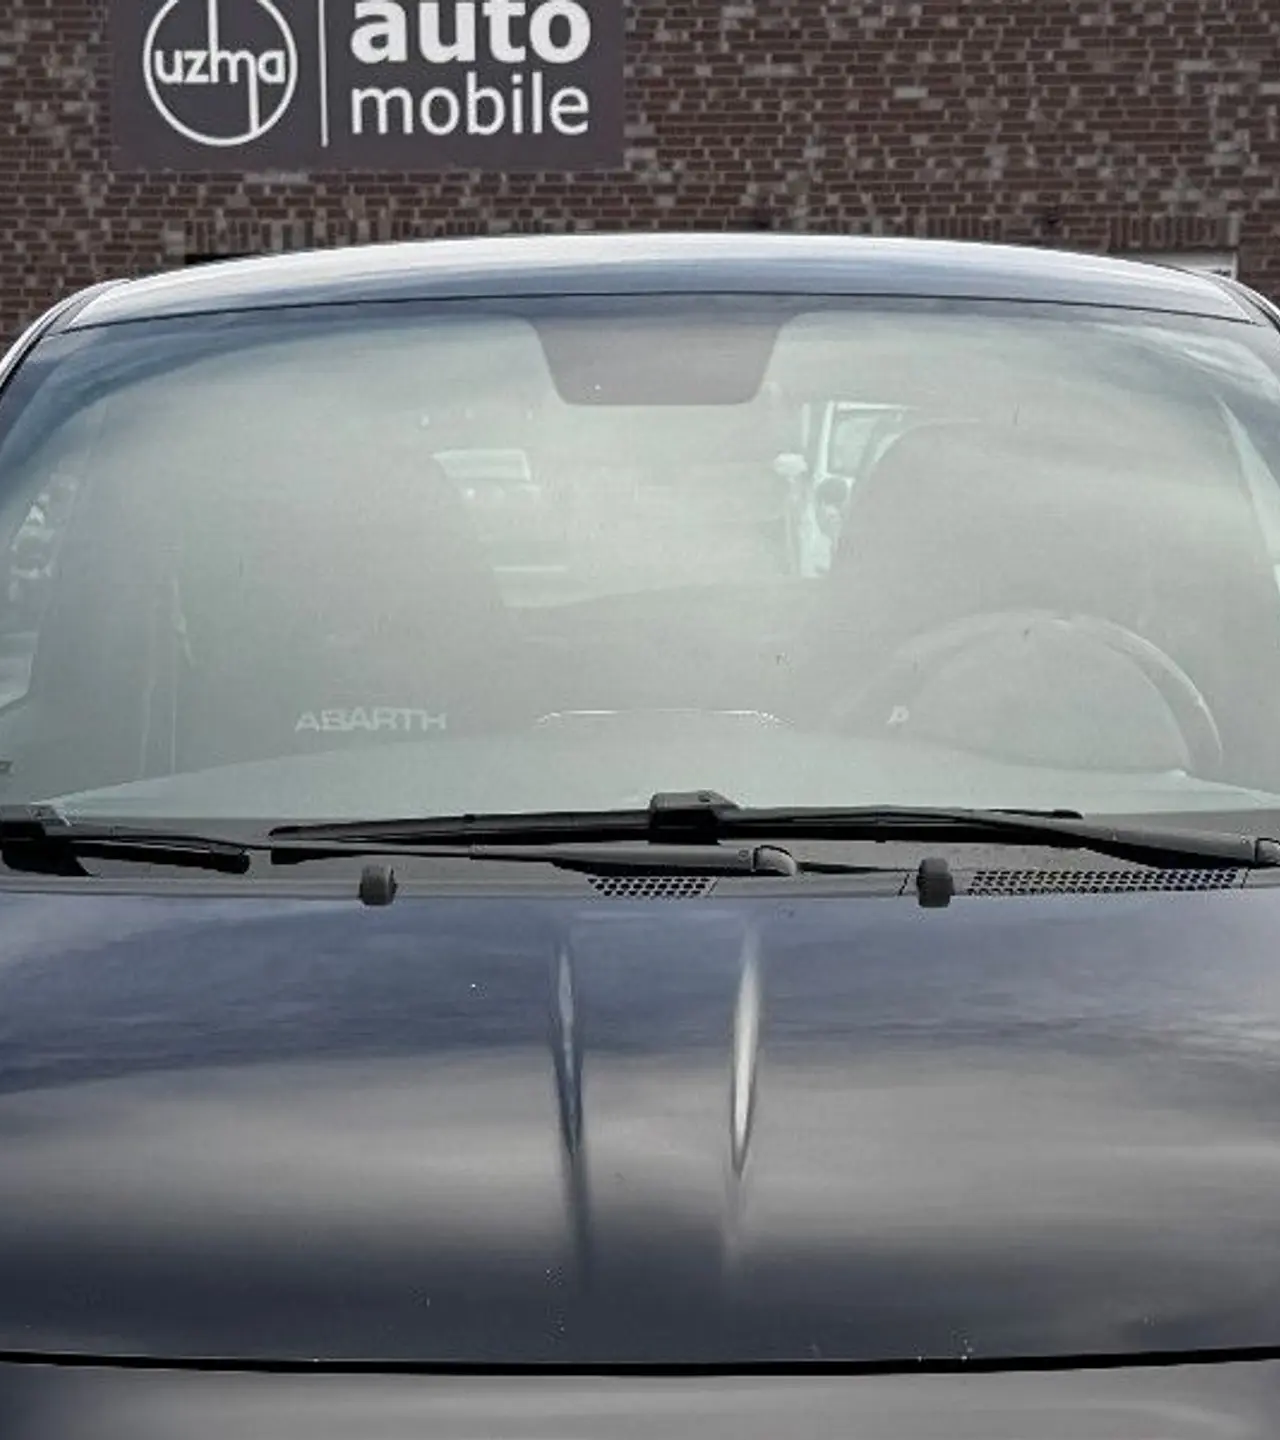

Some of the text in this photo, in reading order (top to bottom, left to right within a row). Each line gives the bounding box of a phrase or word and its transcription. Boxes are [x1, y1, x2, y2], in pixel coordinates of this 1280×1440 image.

[351, 0, 592, 64] auto
[351, 71, 590, 135] mobile
[295, 706, 447, 732] ABARTH
